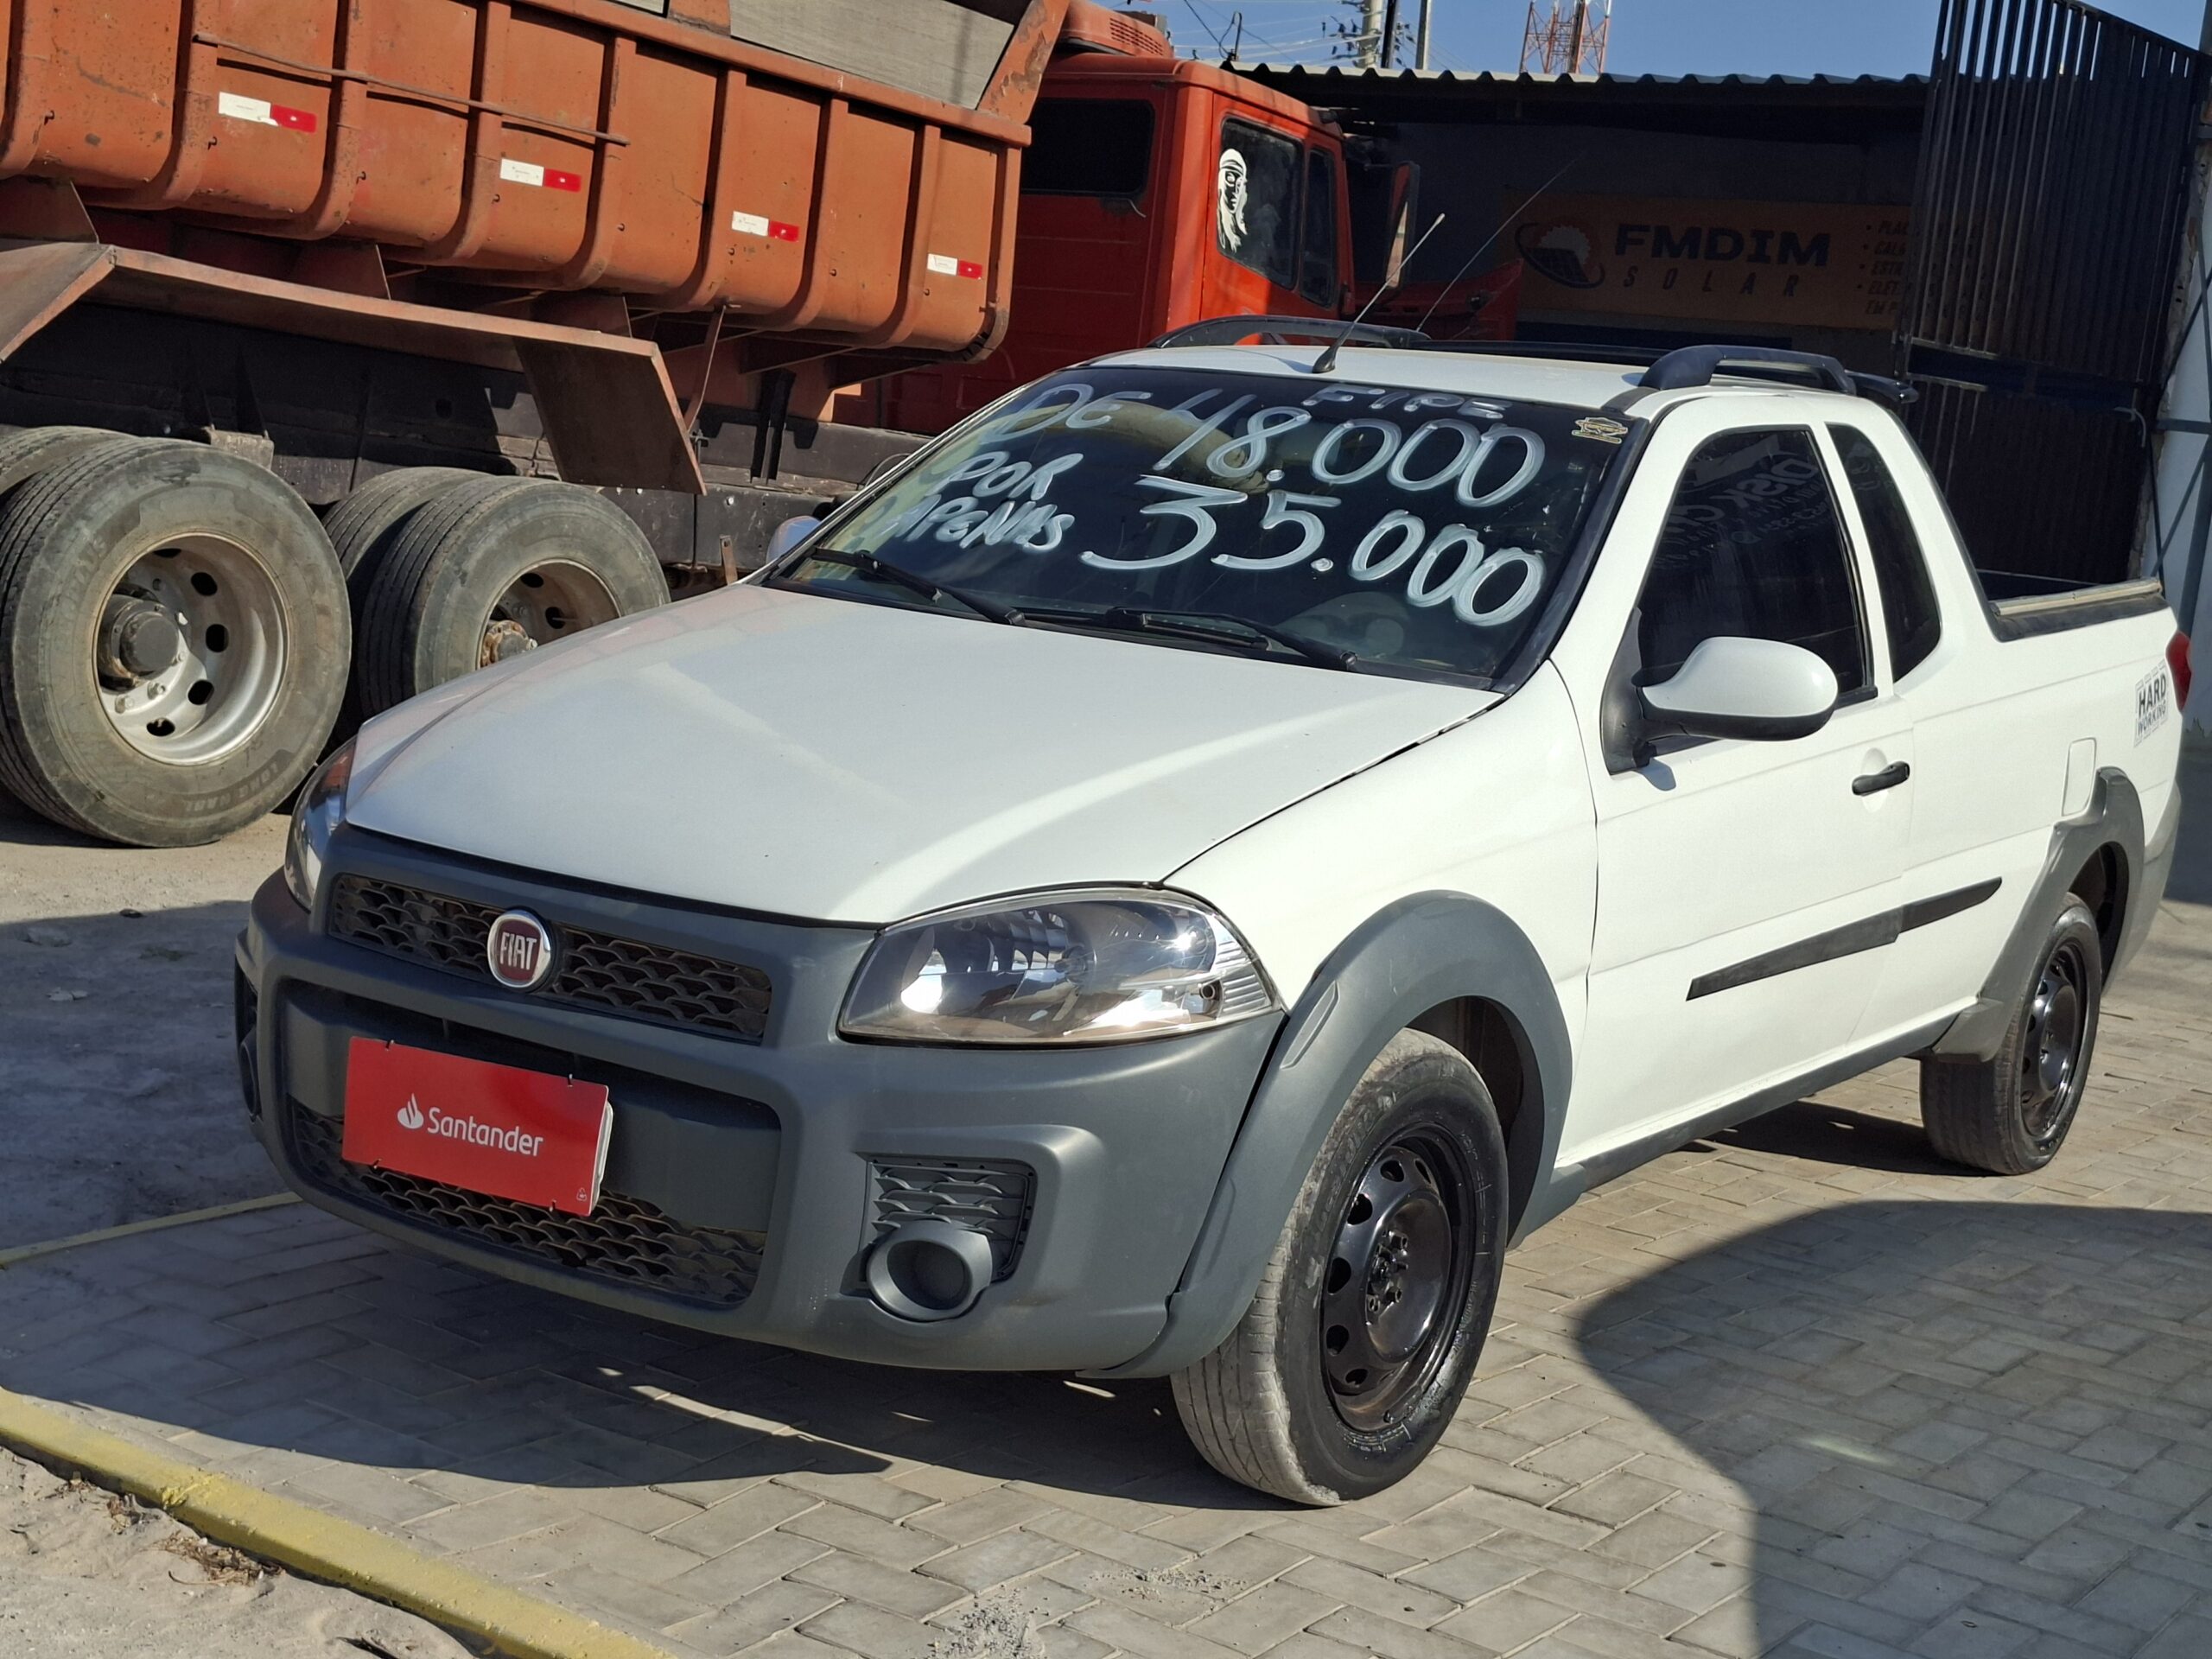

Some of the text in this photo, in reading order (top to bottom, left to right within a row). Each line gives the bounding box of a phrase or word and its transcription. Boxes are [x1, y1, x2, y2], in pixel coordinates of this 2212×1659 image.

[1615, 223, 1831, 267] FMDIM
[1624, 265, 1800, 297] SOLAR
[1302, 384, 1512, 419] FIPE
[923, 450, 1084, 502] POR
[1080, 474, 1546, 626] 35.000
[2138, 673, 2167, 718] HARD
[2138, 700, 2167, 737] WORKING
[499, 931, 537, 970] FIAT
[427, 1107, 544, 1157] Santander
